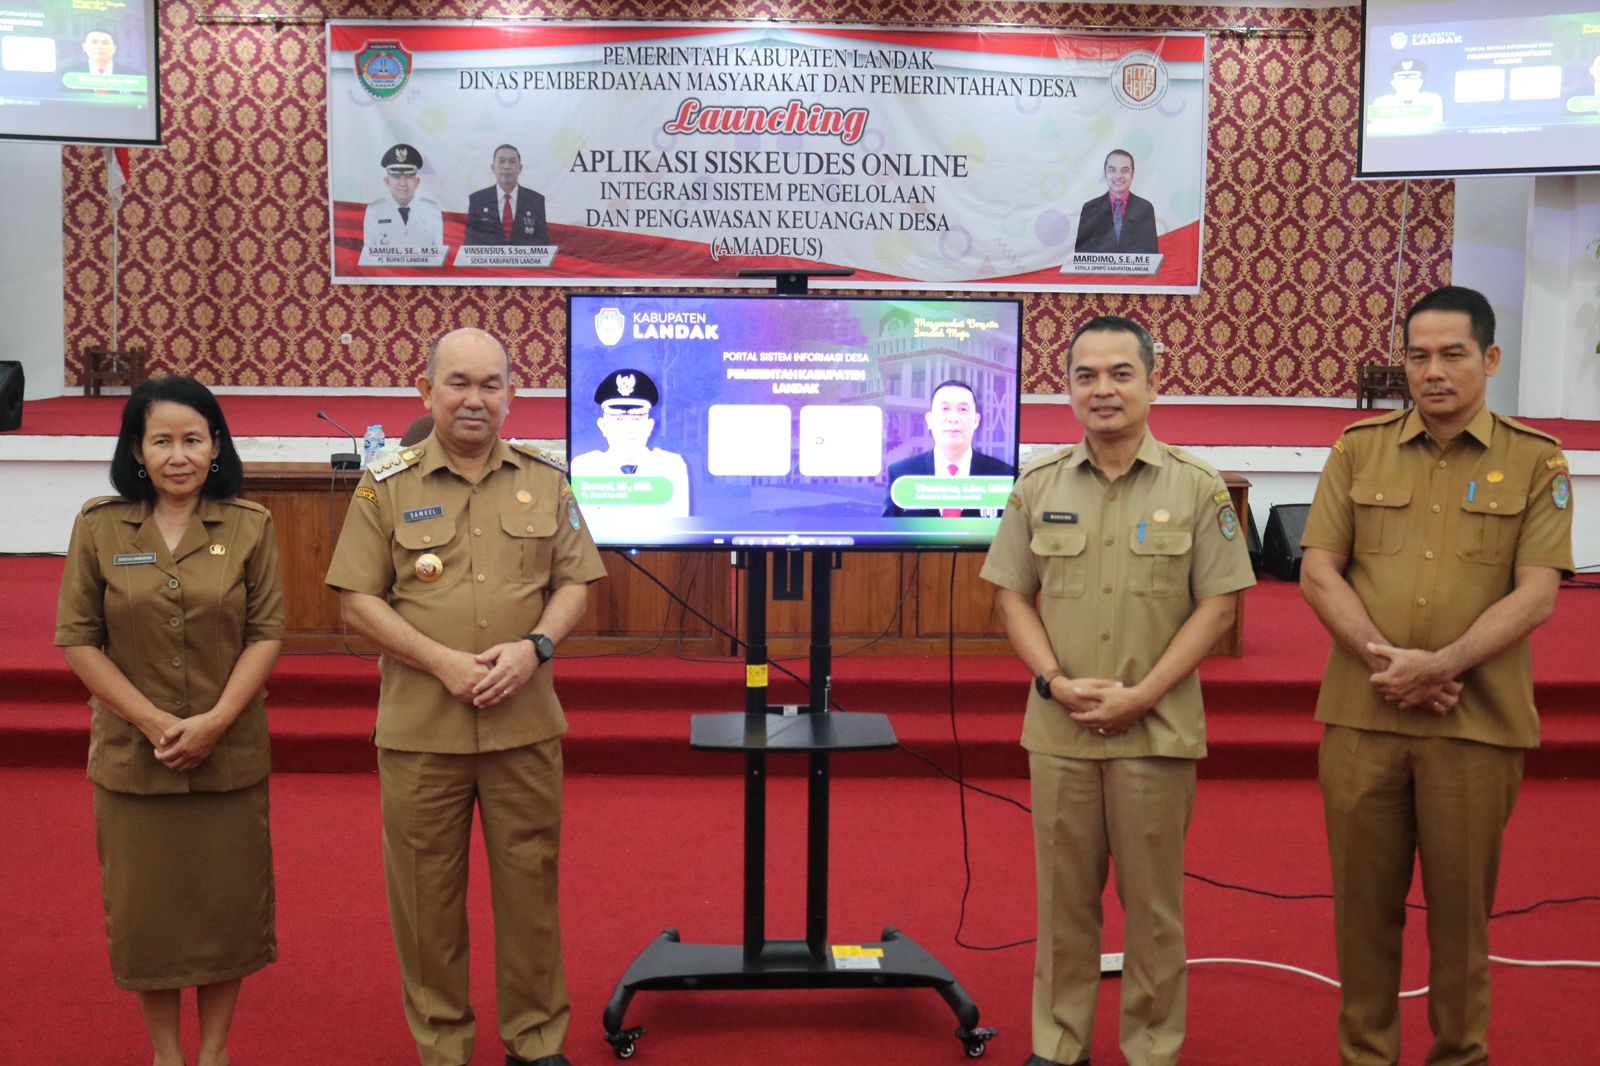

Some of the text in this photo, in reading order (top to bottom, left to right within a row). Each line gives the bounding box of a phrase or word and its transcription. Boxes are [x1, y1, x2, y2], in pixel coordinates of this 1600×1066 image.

[1412, 36, 1462, 46] LANDAK
[603, 46, 935, 70] PEMERINTAH KABUPATEN LANDAK
[459, 70, 1078, 98] DINAS PEMBERDAYAAN MASYARAKAT DAN PEMERINTAHAN DESA
[664, 98, 869, 145] Launching
[569, 150, 969, 178] APLIKASI SISKEUDES ONLINE
[600, 181, 936, 204] INTEGRASI SISTEM PENGELOLAAN
[585, 208, 950, 232] DAN PENGAWASAN KEUANGAN DESA
[368, 247, 400, 255] SAMUEL,
[464, 247, 507, 255] VINSENSIUS,
[711, 236, 823, 262] (AMADEUS)
[1073, 255, 1116, 264] MARDIMO,
[633, 312, 706, 324] KABUPATEN
[633, 324, 719, 340] LANDAK
[723, 351, 870, 363] PORTAL SISTEM INFORMASI DESA
[772, 383, 820, 394] LANDAK
[410, 508, 436, 518] SAMUEL
